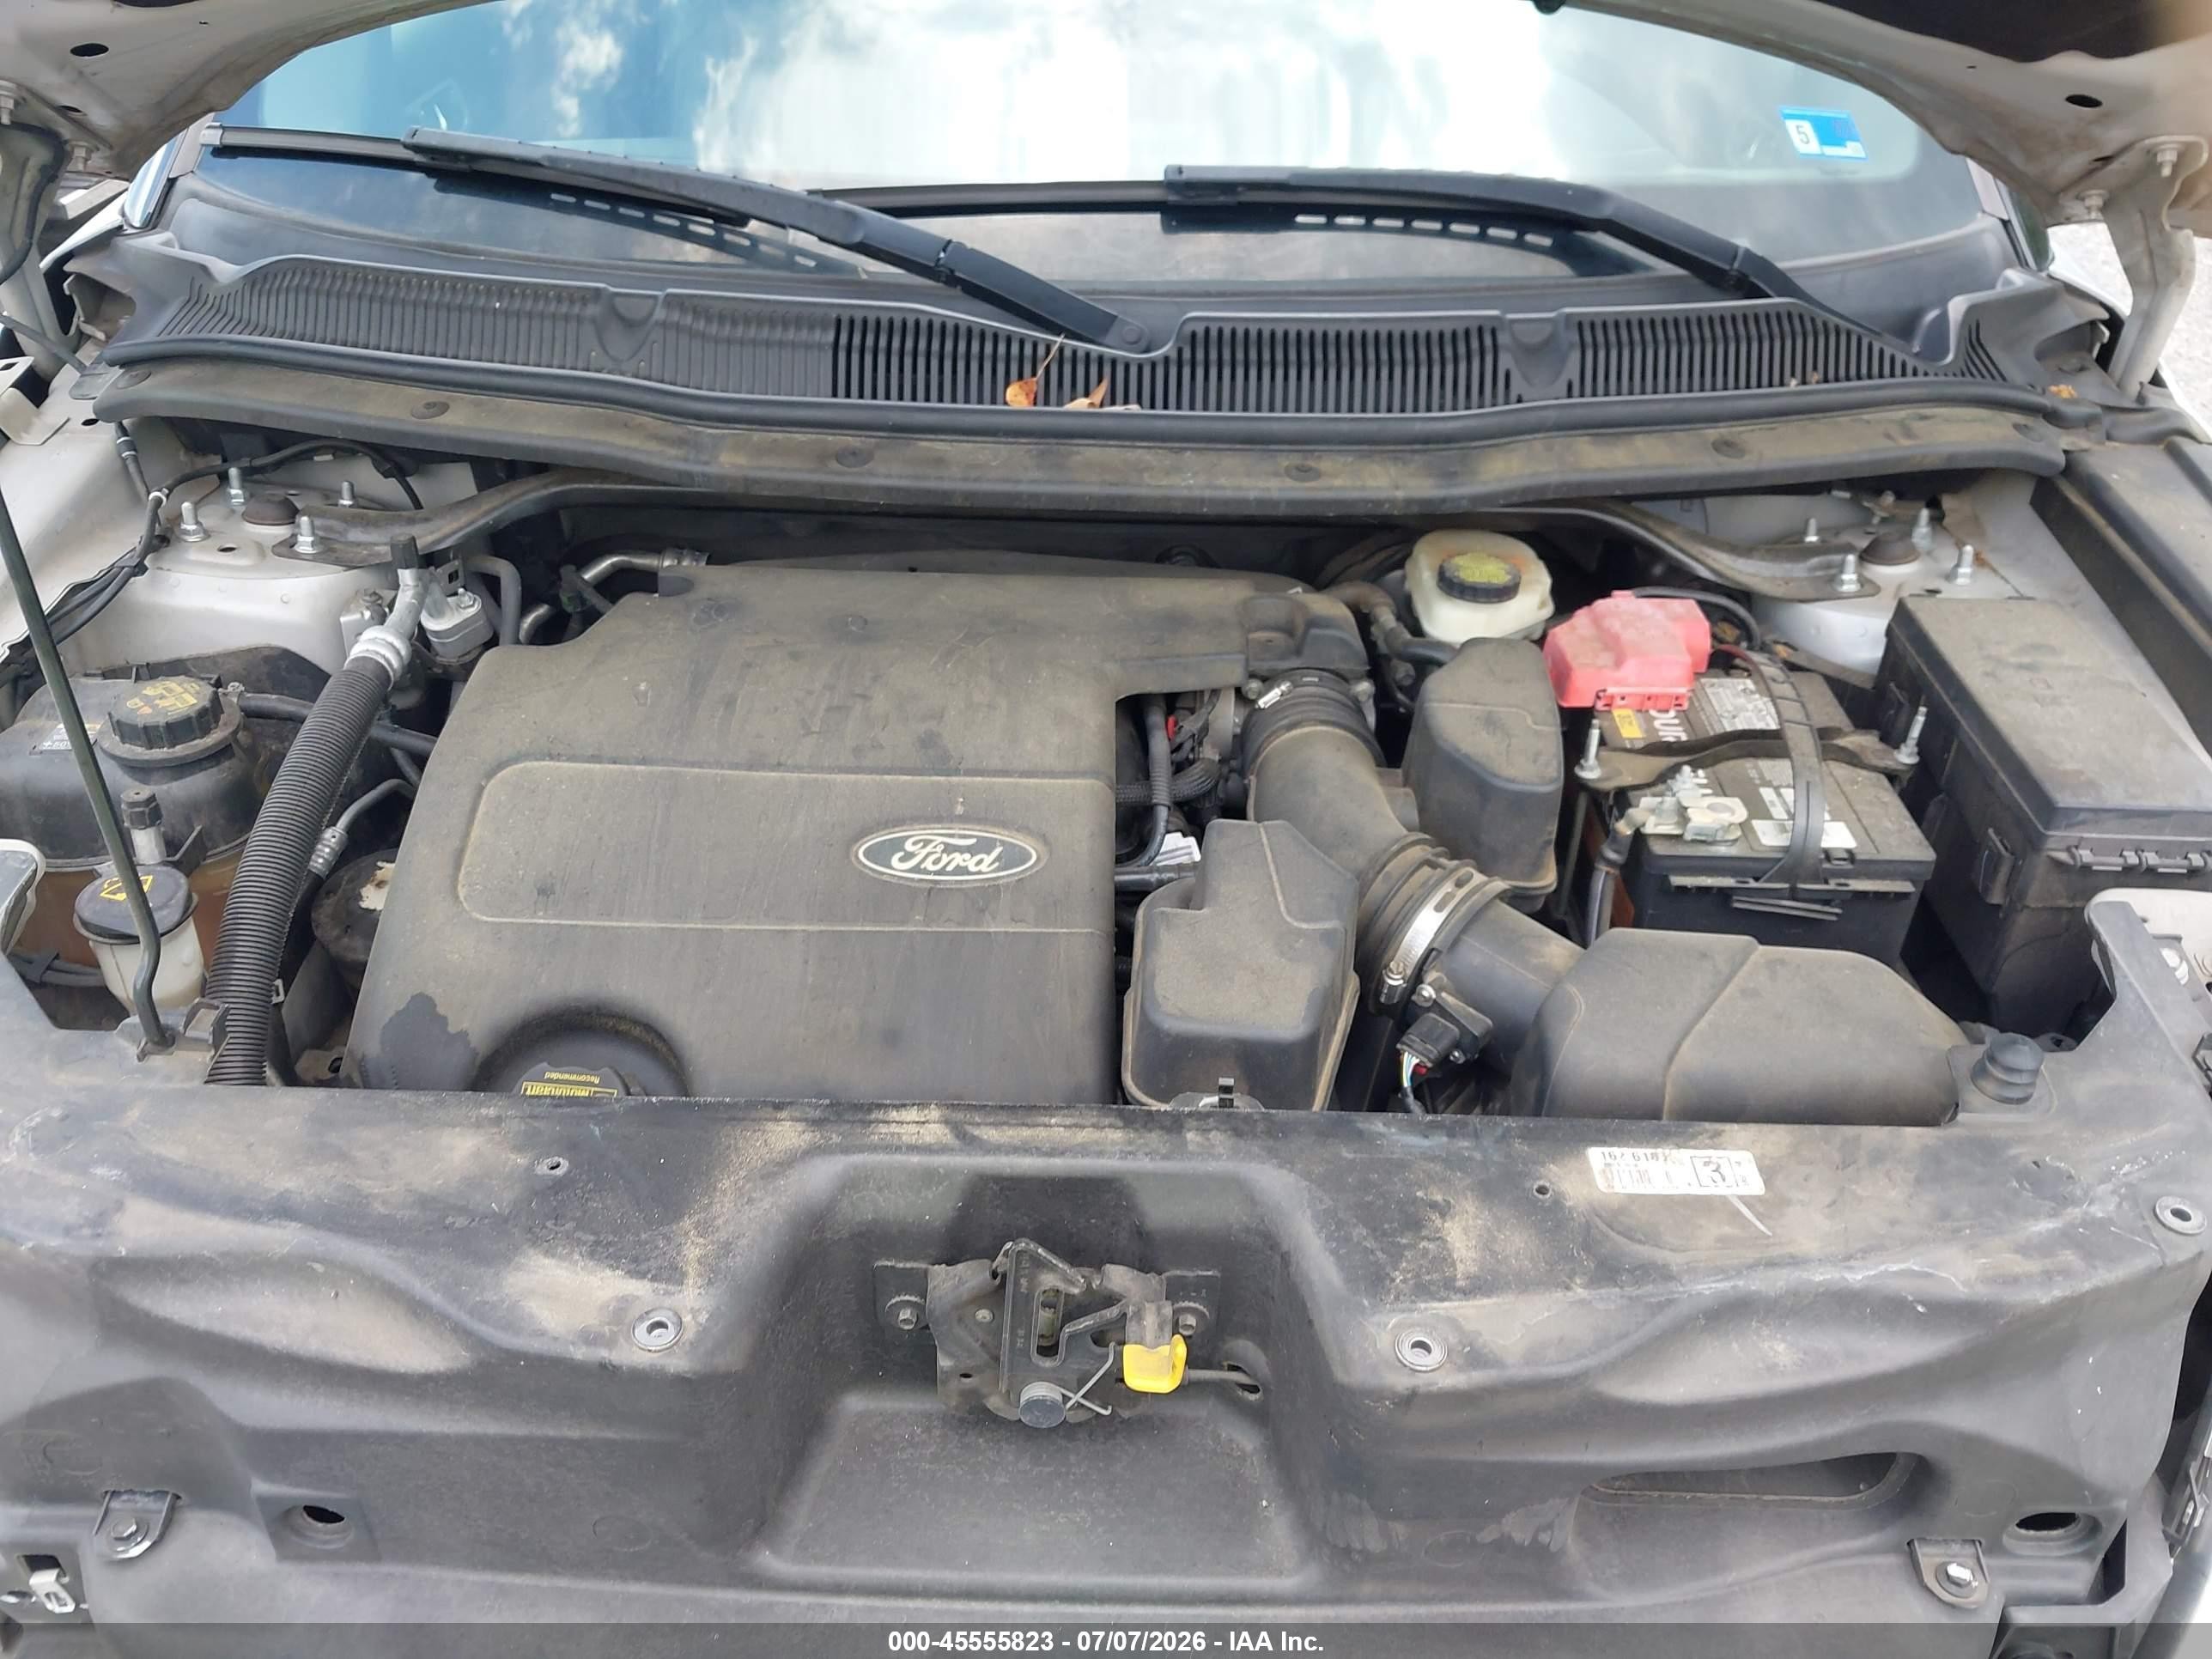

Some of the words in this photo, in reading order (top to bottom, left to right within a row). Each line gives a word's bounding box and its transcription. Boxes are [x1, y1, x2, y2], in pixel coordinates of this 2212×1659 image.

[1796, 125, 1810, 145] 5
[890, 834, 1004, 873] Ford
[544, 1071, 601, 1085] Recommended
